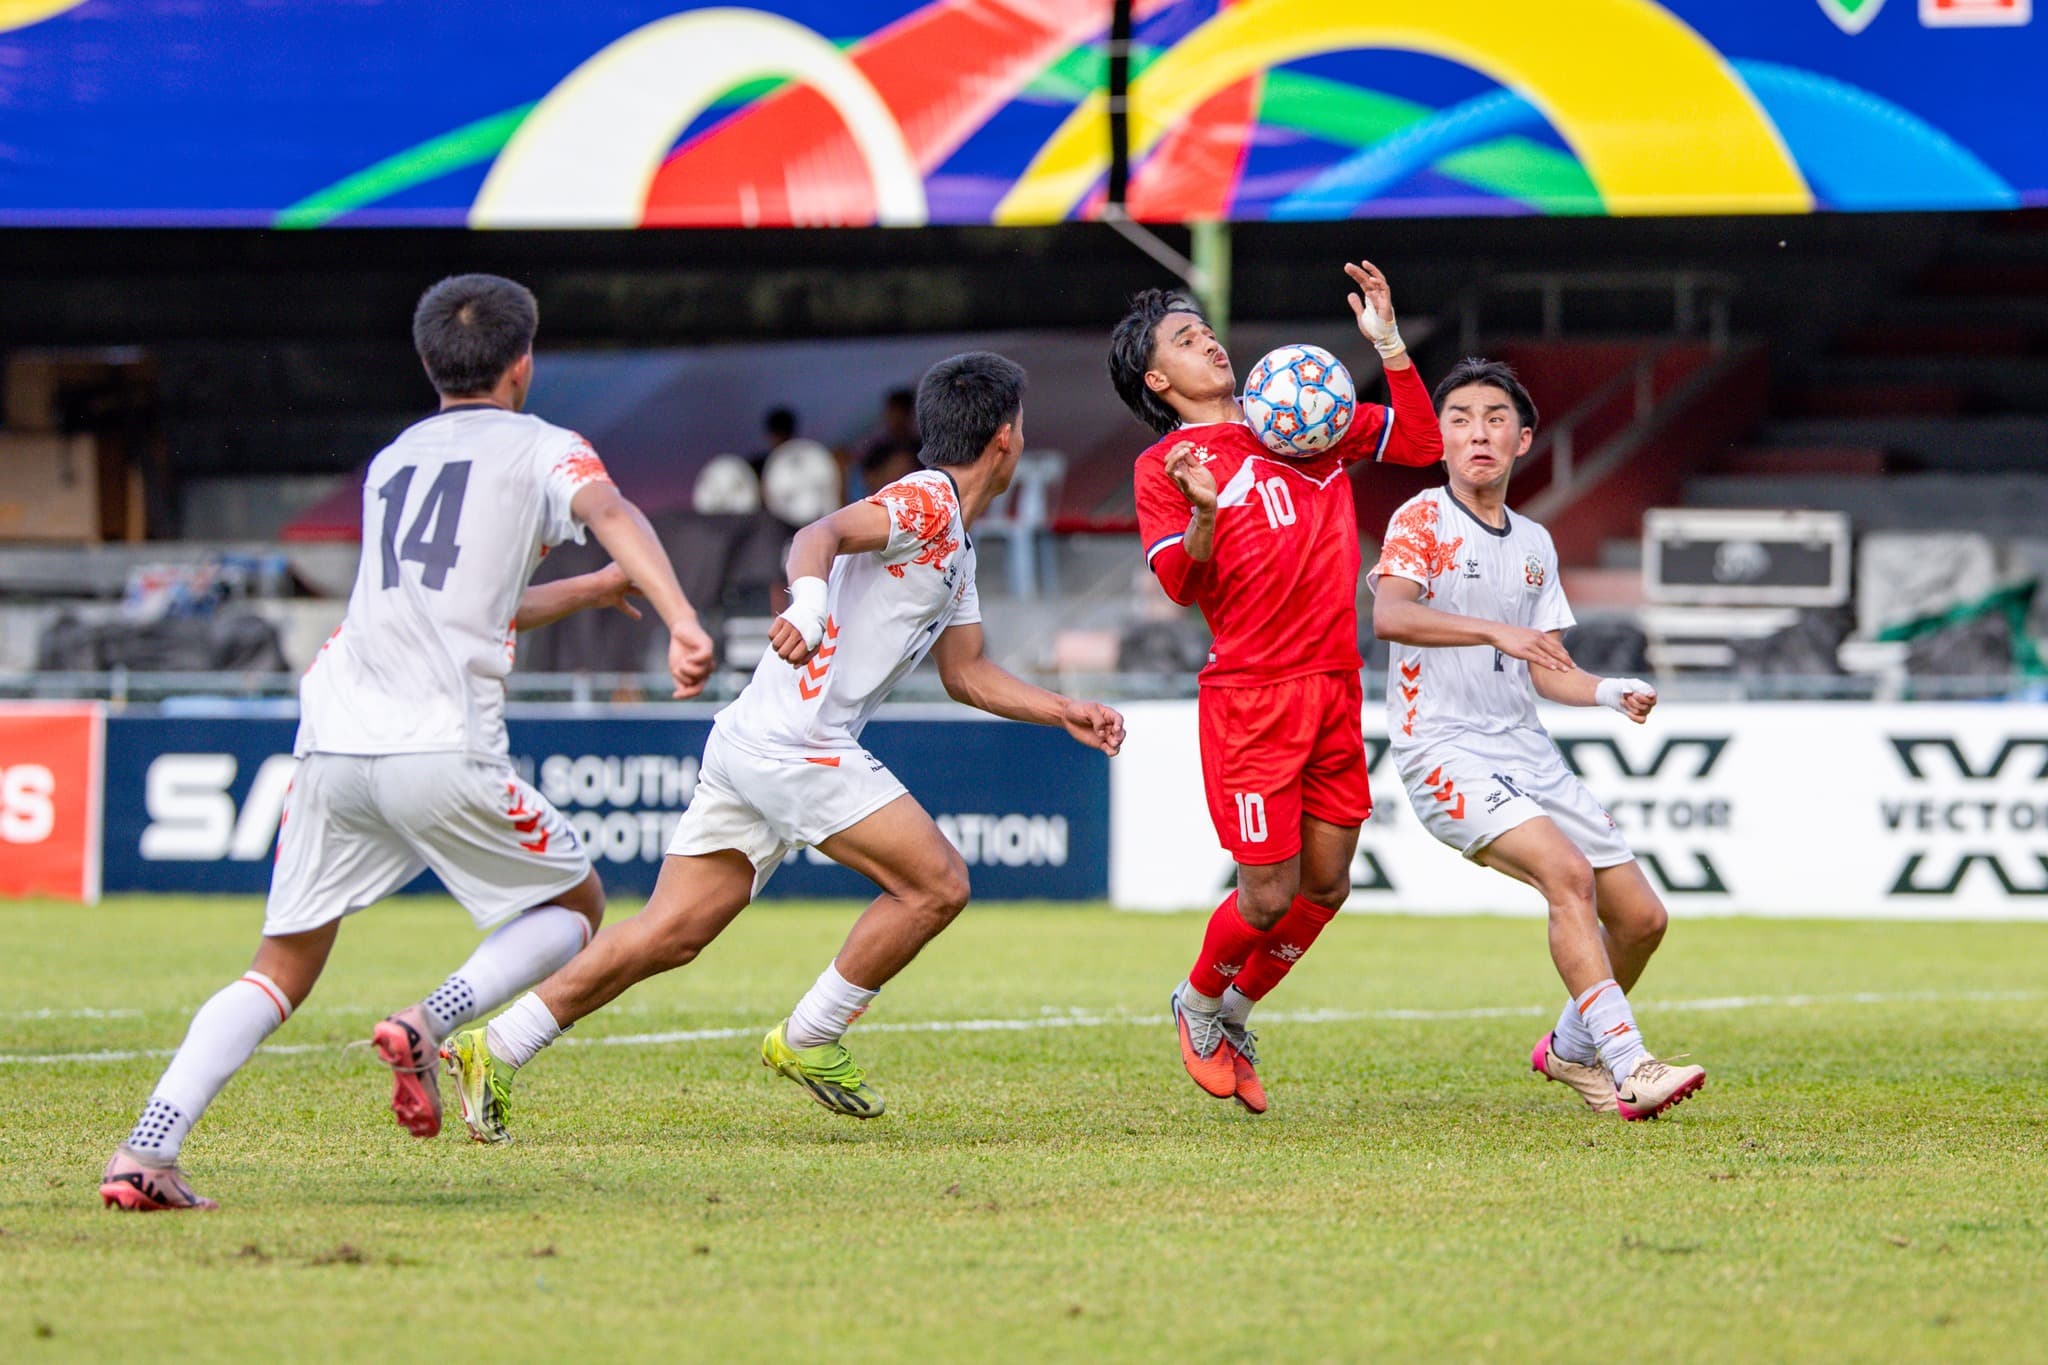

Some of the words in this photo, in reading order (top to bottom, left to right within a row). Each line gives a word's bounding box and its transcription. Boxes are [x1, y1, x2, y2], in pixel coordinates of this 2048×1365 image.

[378, 459, 474, 592] 14
[1255, 475, 1297, 530] 10
[0, 763, 56, 844] S
[540, 754, 700, 809] SOUTH
[1234, 791, 1269, 843] 10
[1606, 800, 1731, 830] CTOR
[1879, 799, 2048, 832] VECTO
